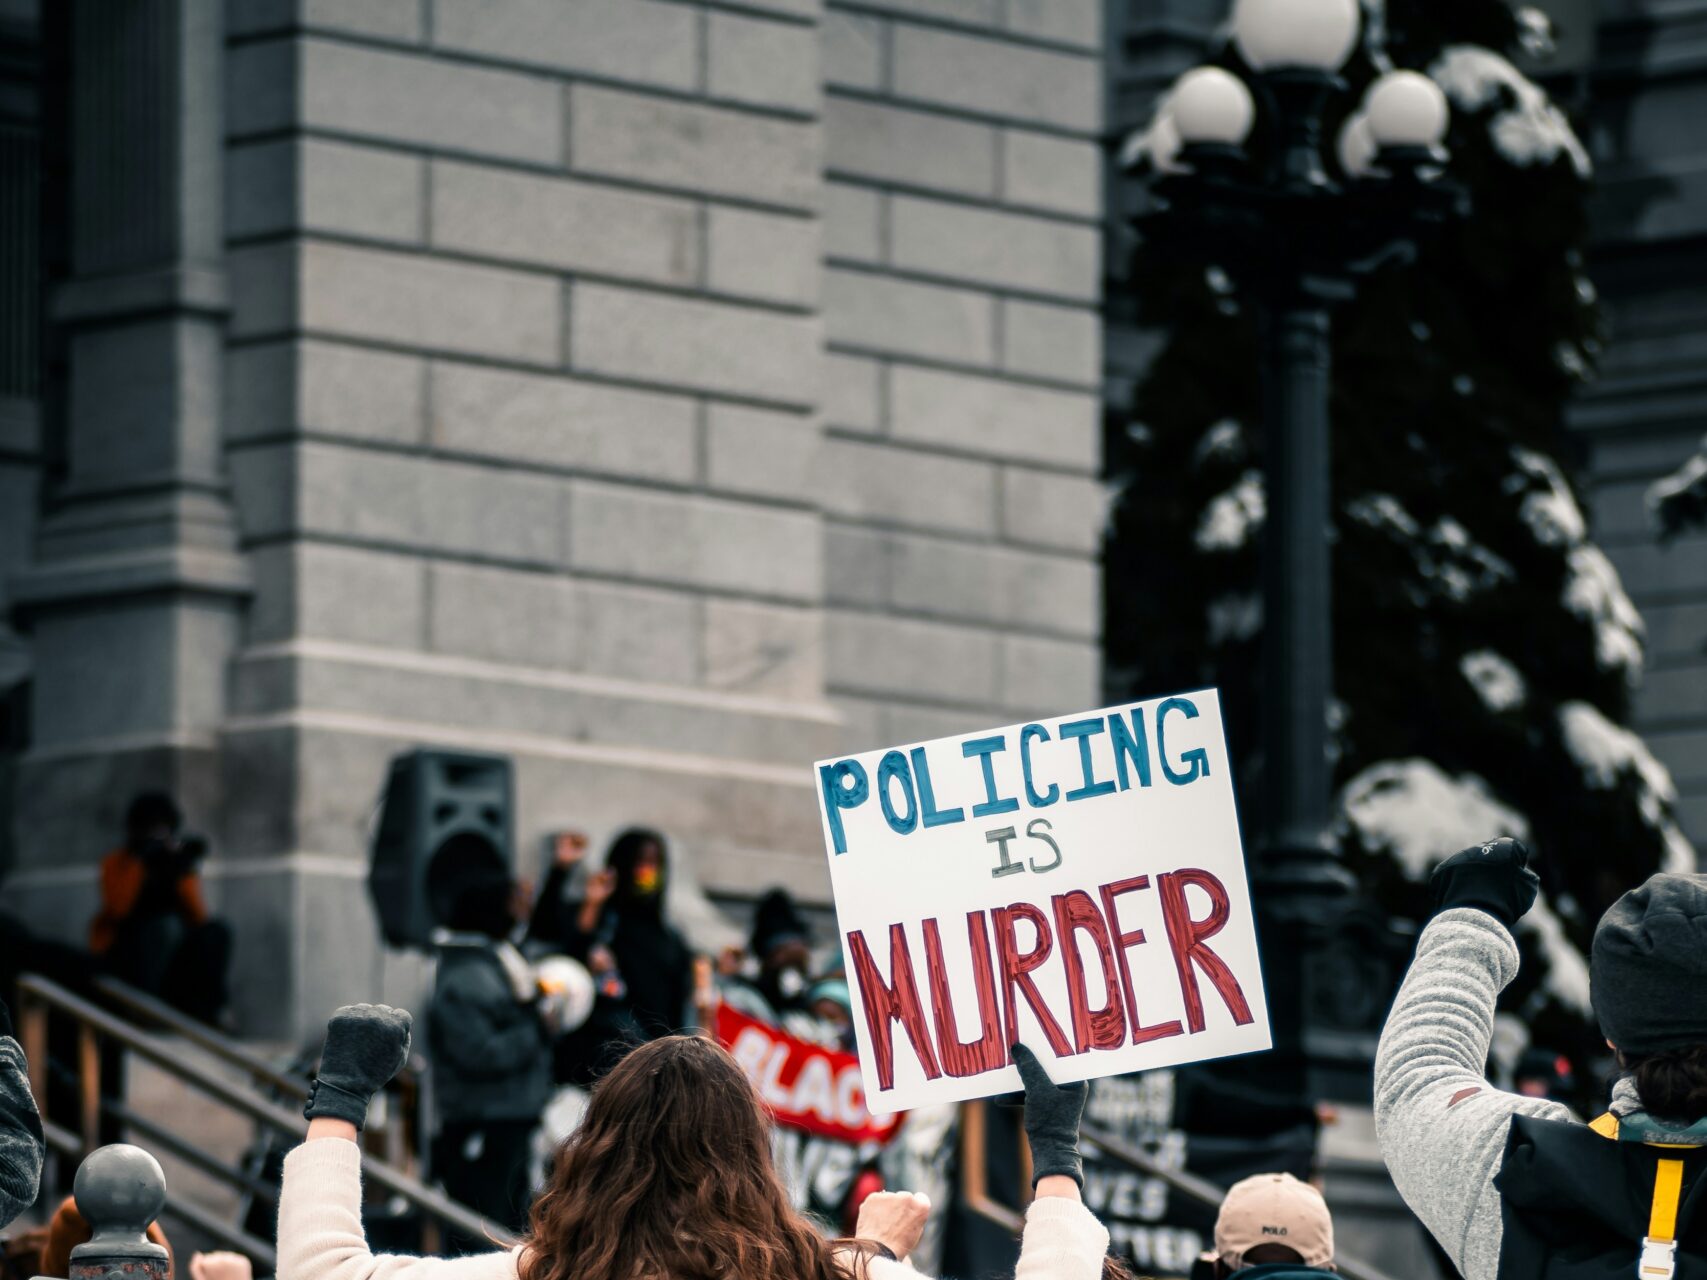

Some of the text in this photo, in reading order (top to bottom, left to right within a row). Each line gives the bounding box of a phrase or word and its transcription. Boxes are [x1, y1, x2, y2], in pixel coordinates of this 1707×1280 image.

[820, 698, 1210, 856] POLICING
[985, 818, 1062, 878] IS
[847, 868, 1254, 1091] MURDER
[732, 1026, 895, 1130] BLAC
[1262, 1226, 1287, 1236] POLO
